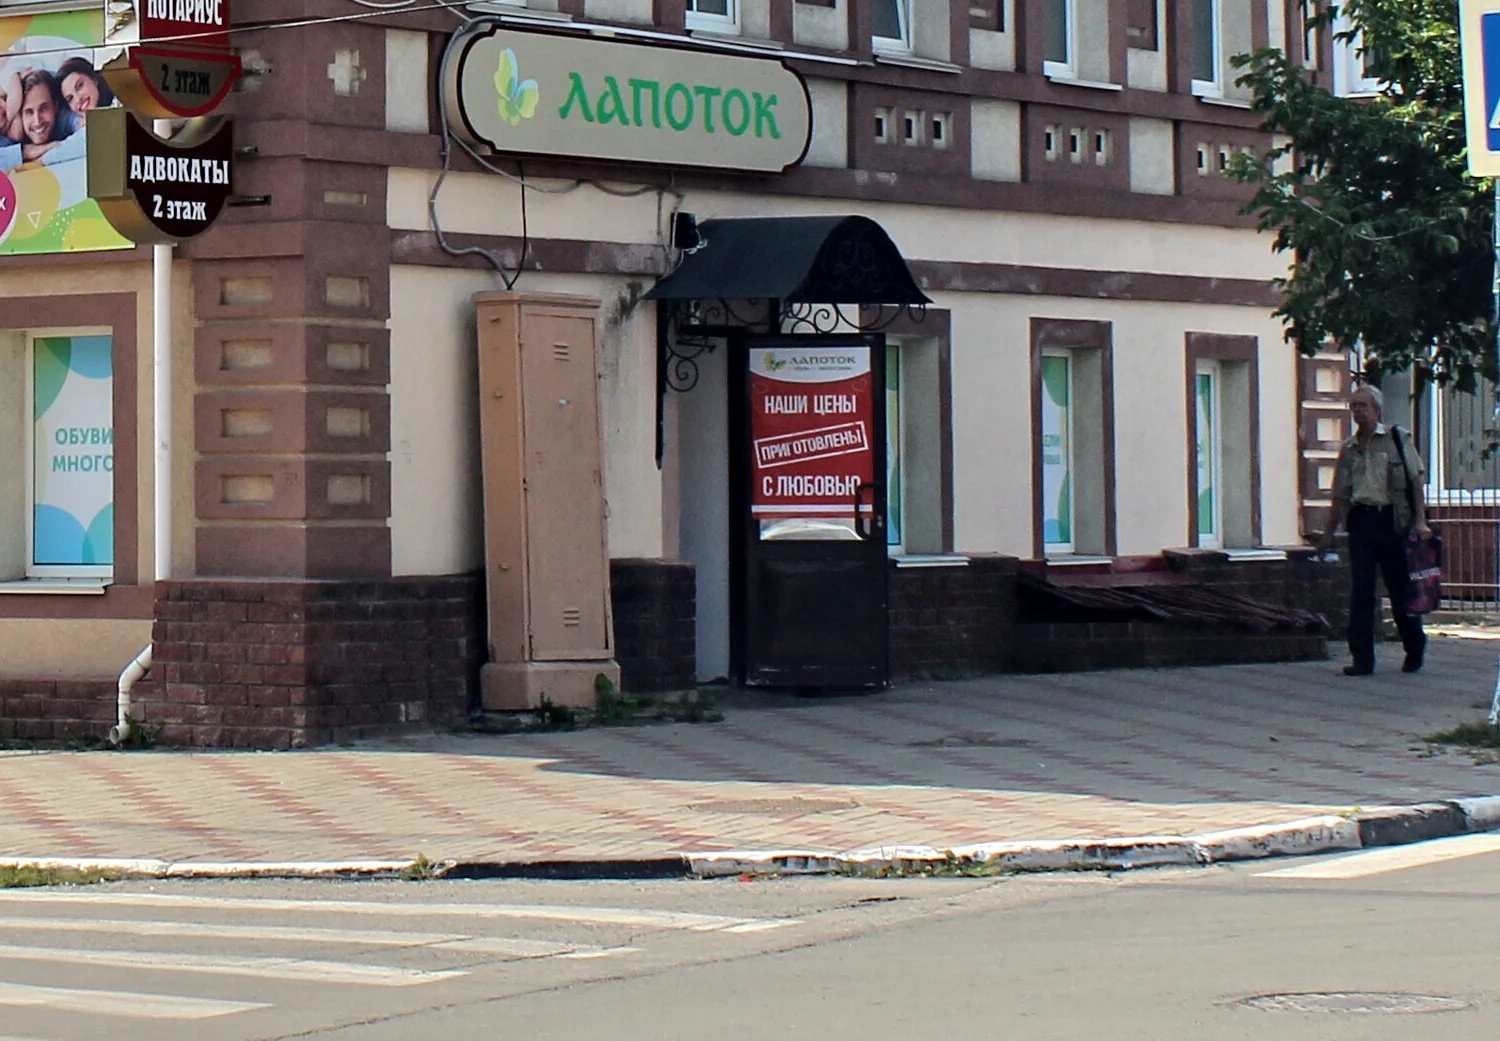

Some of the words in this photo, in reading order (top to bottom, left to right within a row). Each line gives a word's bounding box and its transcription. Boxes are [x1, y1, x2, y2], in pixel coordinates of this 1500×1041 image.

[161, 65, 169, 92] 2
[174, 67, 211, 96] этаж
[130, 155, 229, 185] АДВОКАТЫ
[153, 195, 163, 219] 2
[166, 199, 206, 221] этаж
[764, 395, 807, 414] НАШИ
[814, 394, 856, 415] ЦЕНЫ
[761, 429, 862, 461] ПРИГОТОВЛЕНЫ
[762, 475, 773, 497] С
